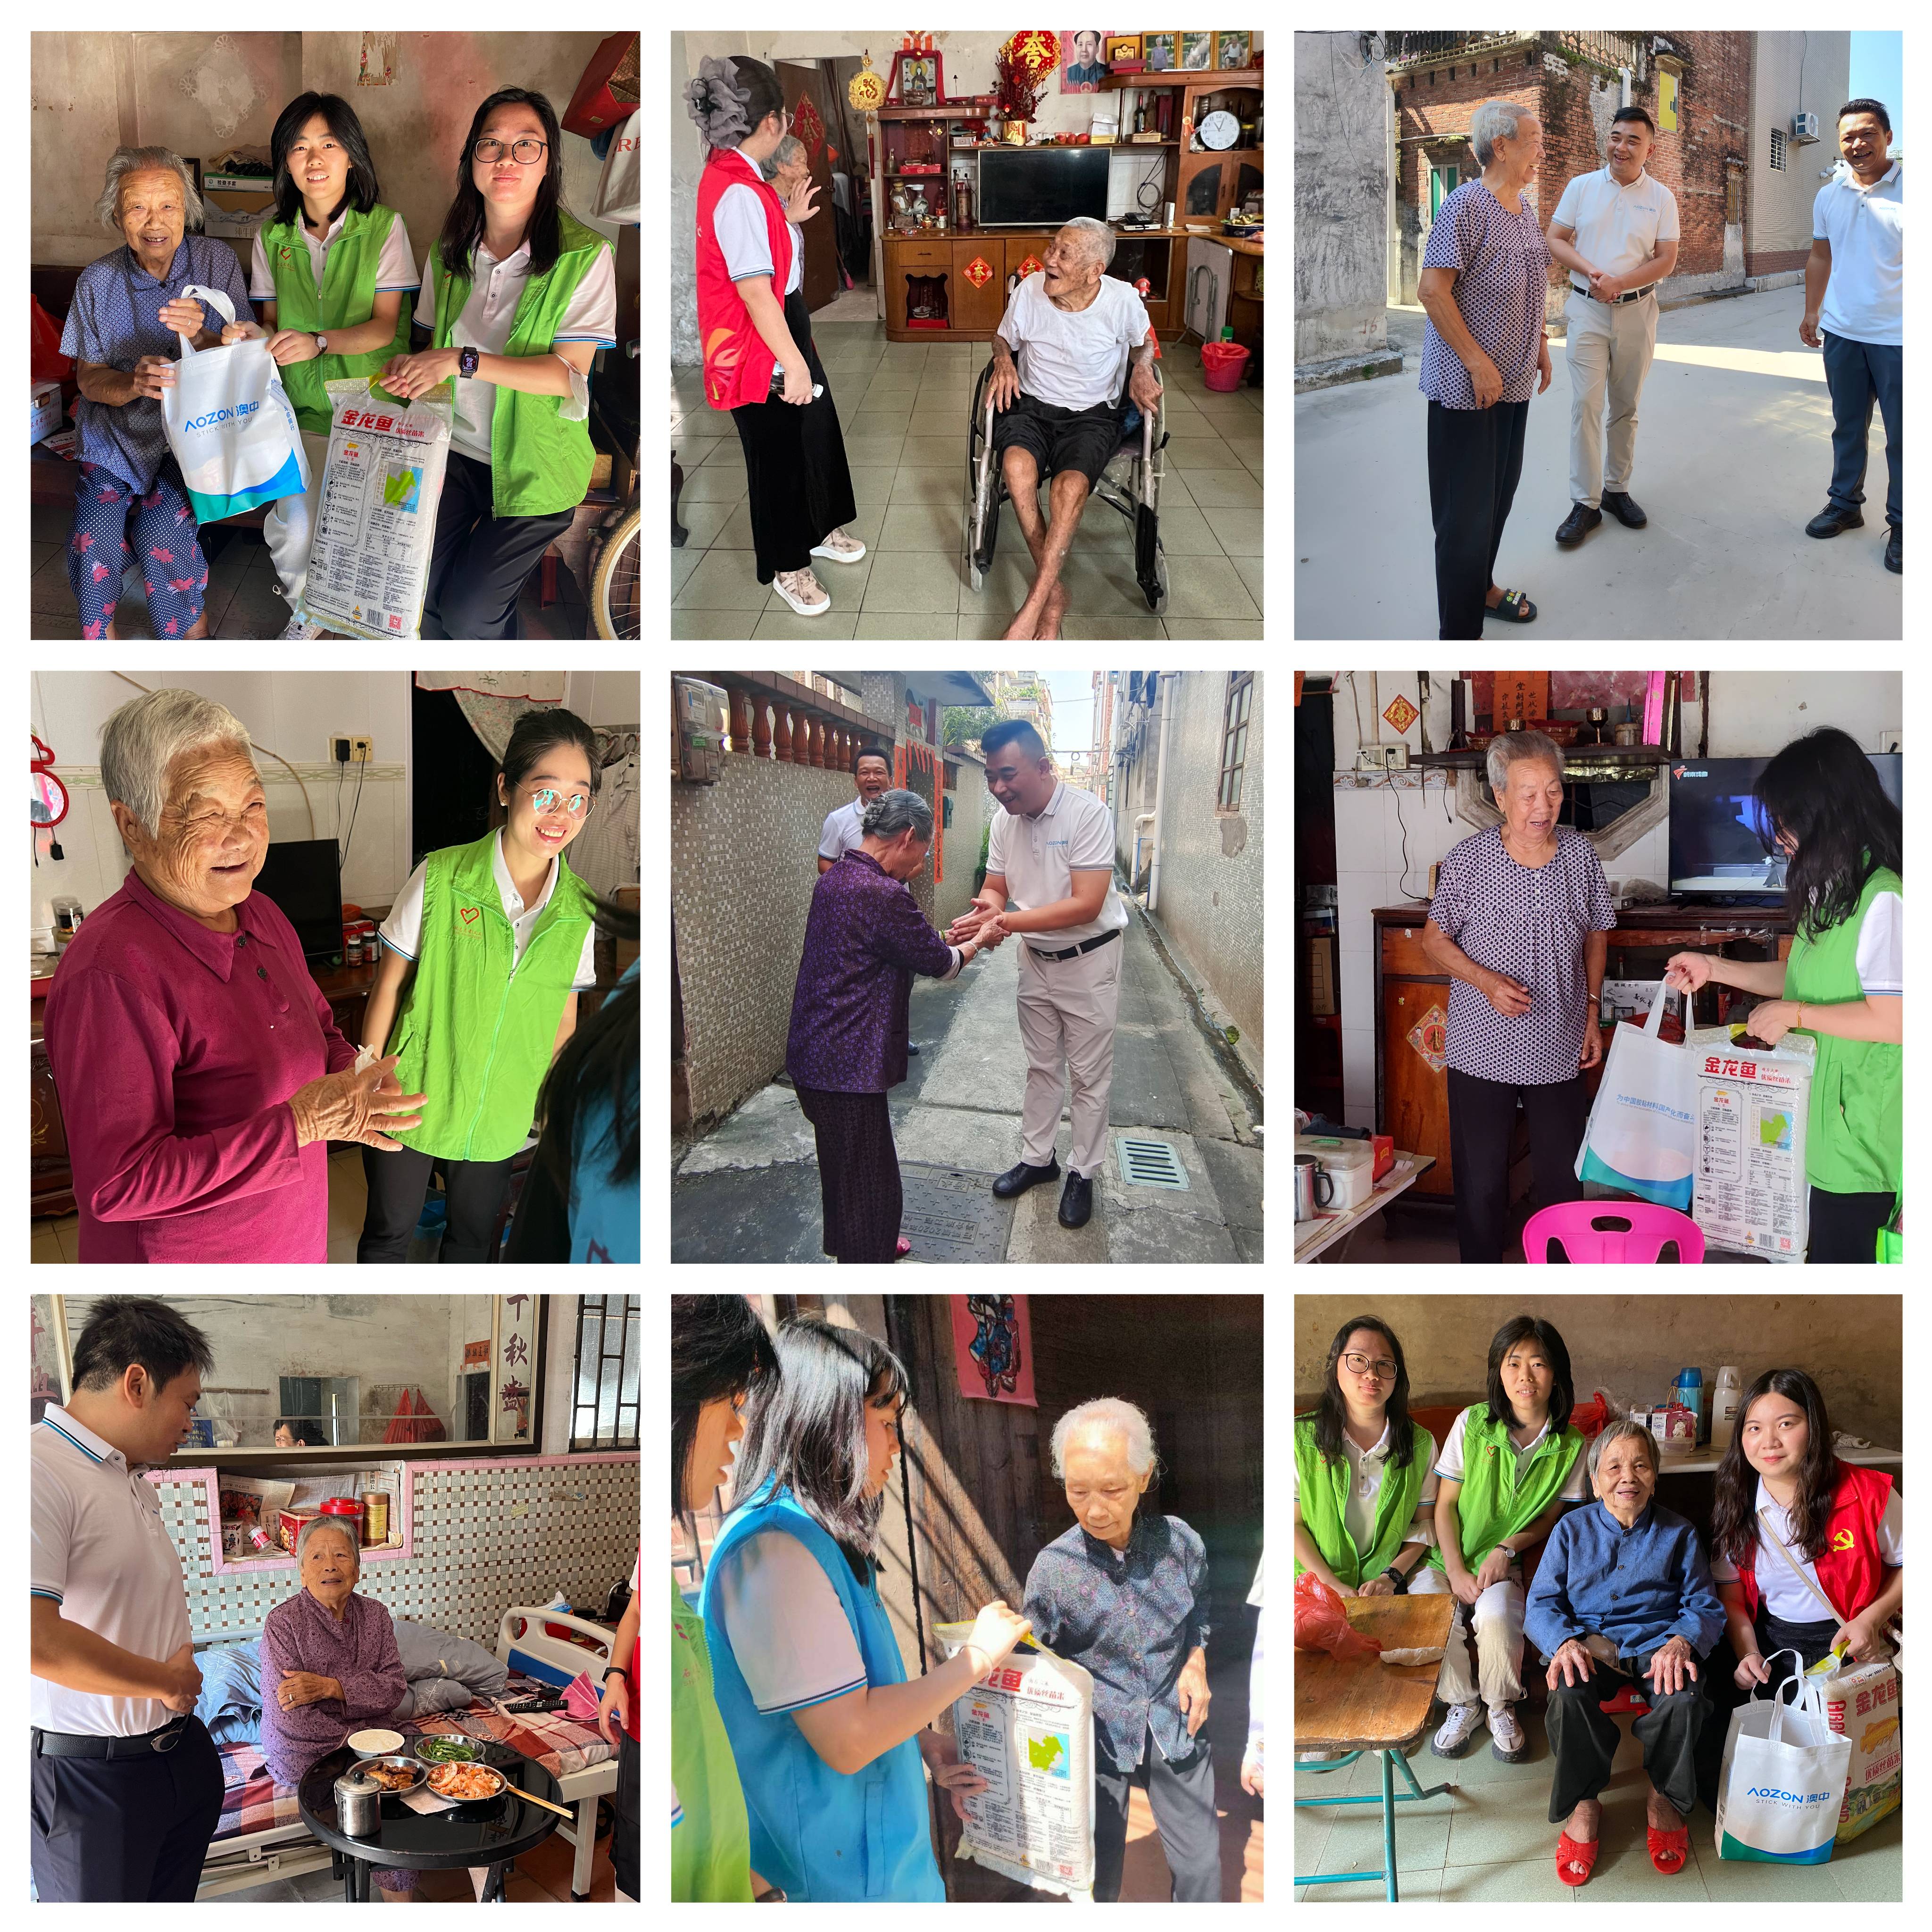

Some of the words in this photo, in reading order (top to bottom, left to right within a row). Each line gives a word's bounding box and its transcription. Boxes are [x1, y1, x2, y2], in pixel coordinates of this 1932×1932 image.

[184, 406, 234, 433] AOZON
[235, 401, 259, 416] 澳中
[196, 425, 219, 438] STICK
[221, 421, 235, 429] WITH
[238, 416, 252, 425] YOU
[341, 409, 395, 432] 金龙鱼
[343, 450, 359, 458] 金龙鱼
[1704, 1056, 1757, 1079] 金龙鱼
[978, 1666, 1023, 1692] 龙鱼
[1856, 1677, 1899, 1717] 金龙鱼
[1865, 1752, 1900, 1782] 优质丝苗米
[1747, 1787, 1804, 1803] AOZON
[1806, 1791, 1830, 1803] 澳中
[1782, 1802, 1801, 1810] WITH
